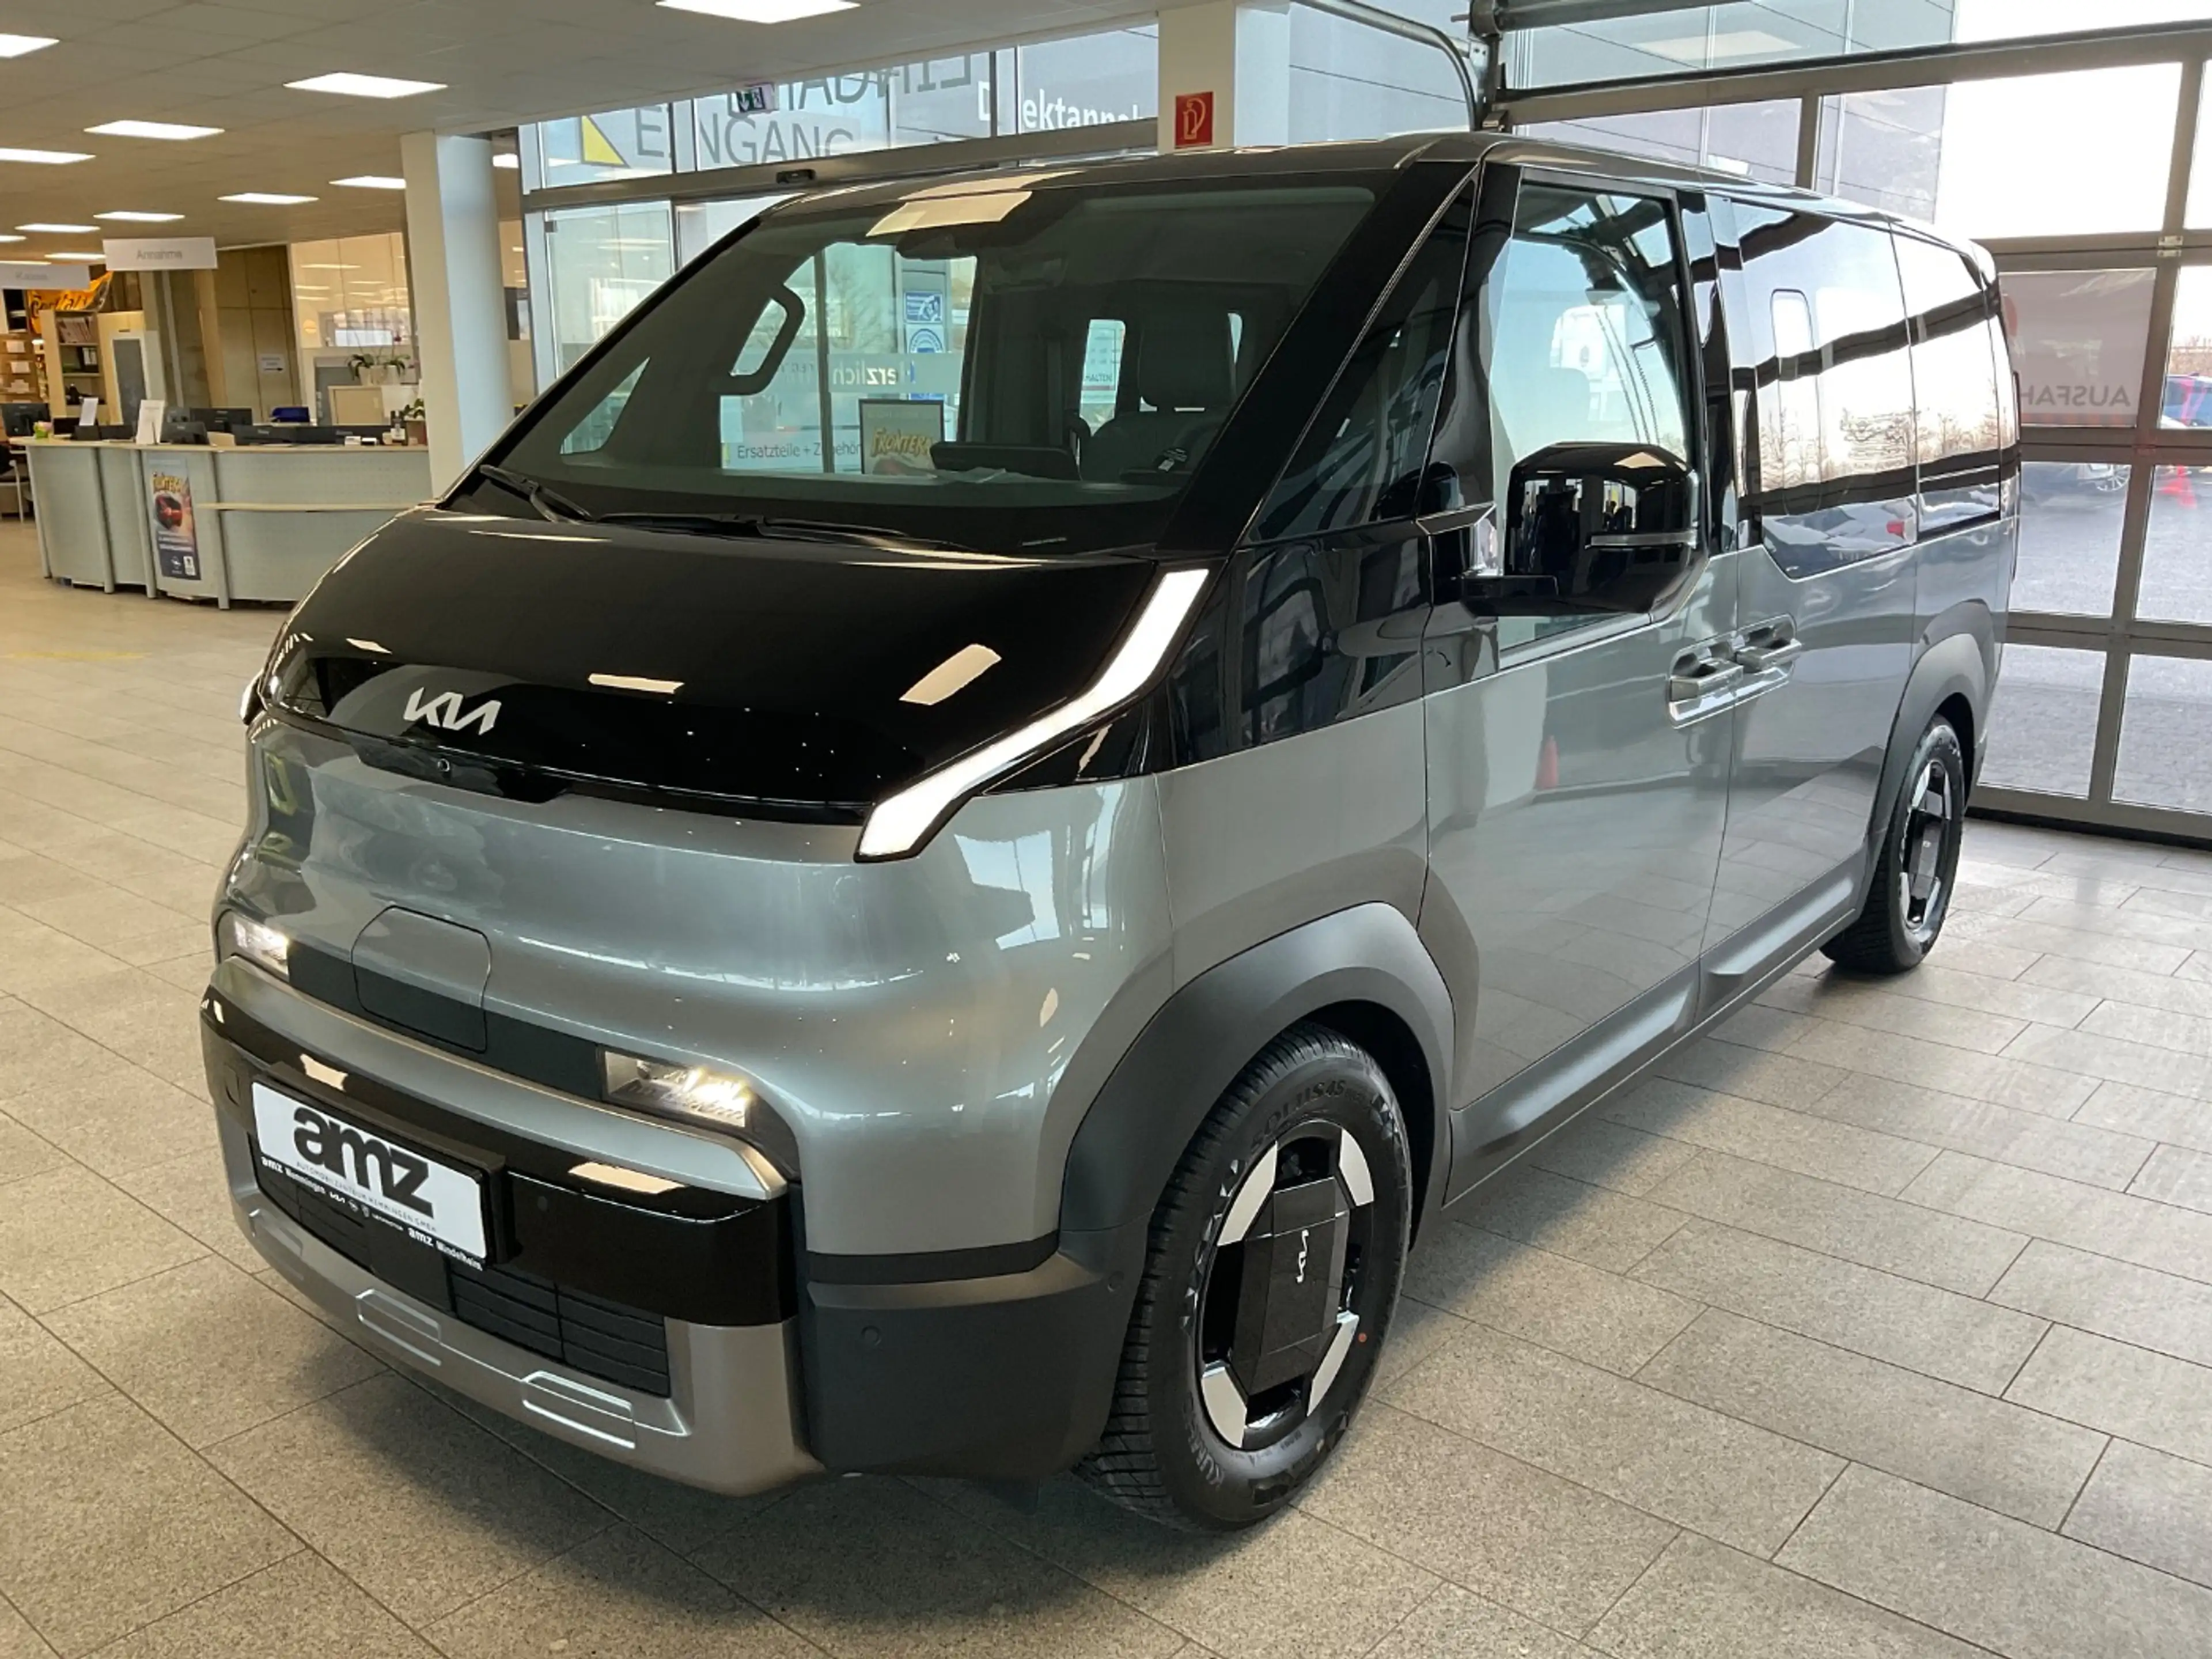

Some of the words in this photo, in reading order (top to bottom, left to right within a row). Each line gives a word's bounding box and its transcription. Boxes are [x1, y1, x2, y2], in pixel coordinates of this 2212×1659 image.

[737, 443, 801, 459] Ersatzteile
[404, 687, 502, 736] KIA
[294, 1107, 434, 1219] amz
[261, 1156, 284, 1173] amz
[407, 1227, 434, 1247] amz
